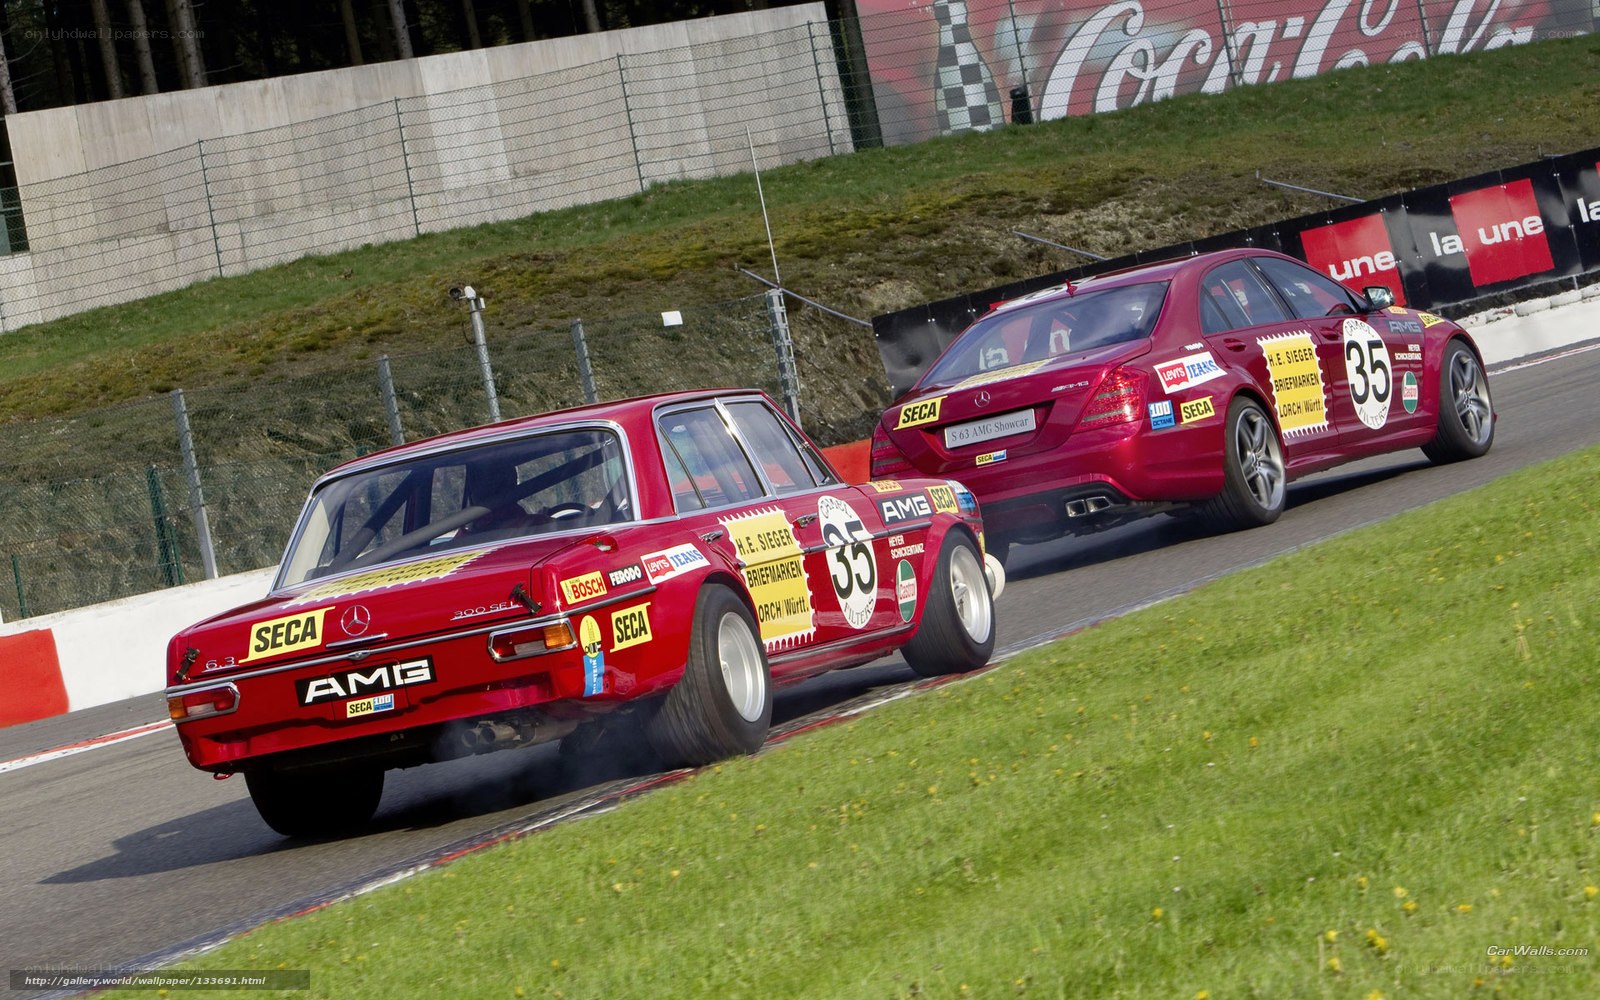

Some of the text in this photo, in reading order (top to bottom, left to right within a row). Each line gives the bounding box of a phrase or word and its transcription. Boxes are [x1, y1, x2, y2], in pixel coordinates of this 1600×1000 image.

[1429, 214, 1545, 256] la une
[1328, 250, 1398, 281] une
[1389, 320, 1422, 333] AMG
[1286, 347, 1315, 363] SIEGER
[1186, 359, 1218, 379] JEANS
[1345, 339, 1391, 405] 35
[1274, 371, 1320, 393] BRIEFMARKEN
[901, 401, 937, 424] SECA
[1150, 401, 1171, 417] 100
[1182, 401, 1212, 419] SECA
[1358, 405, 1388, 427] FILTERS
[951, 417, 1029, 442] S 63 AMG Showcar
[1152, 417, 1173, 426] OCTANE
[976, 453, 993, 464] SECA
[881, 495, 932, 522] AMG
[930, 487, 956, 509] SECA
[735, 528, 794, 555] H.E. SIEGER
[889, 534, 905, 547] HEYER
[891, 543, 925, 559] SCHICKENTANZ
[670, 549, 704, 568] JEANS
[823, 520, 876, 599] 35
[609, 565, 642, 587] FERODO
[746, 559, 802, 588] BRIEFMARKEN
[571, 577, 606, 600] BOSCH
[454, 600, 519, 619] 300 SEL
[844, 599, 875, 626] FILTERS
[254, 615, 317, 653] SECA
[614, 610, 649, 644] SECA
[206, 656, 235, 670] 6.3
[304, 659, 432, 704] AMG
[349, 701, 373, 714] SECA
